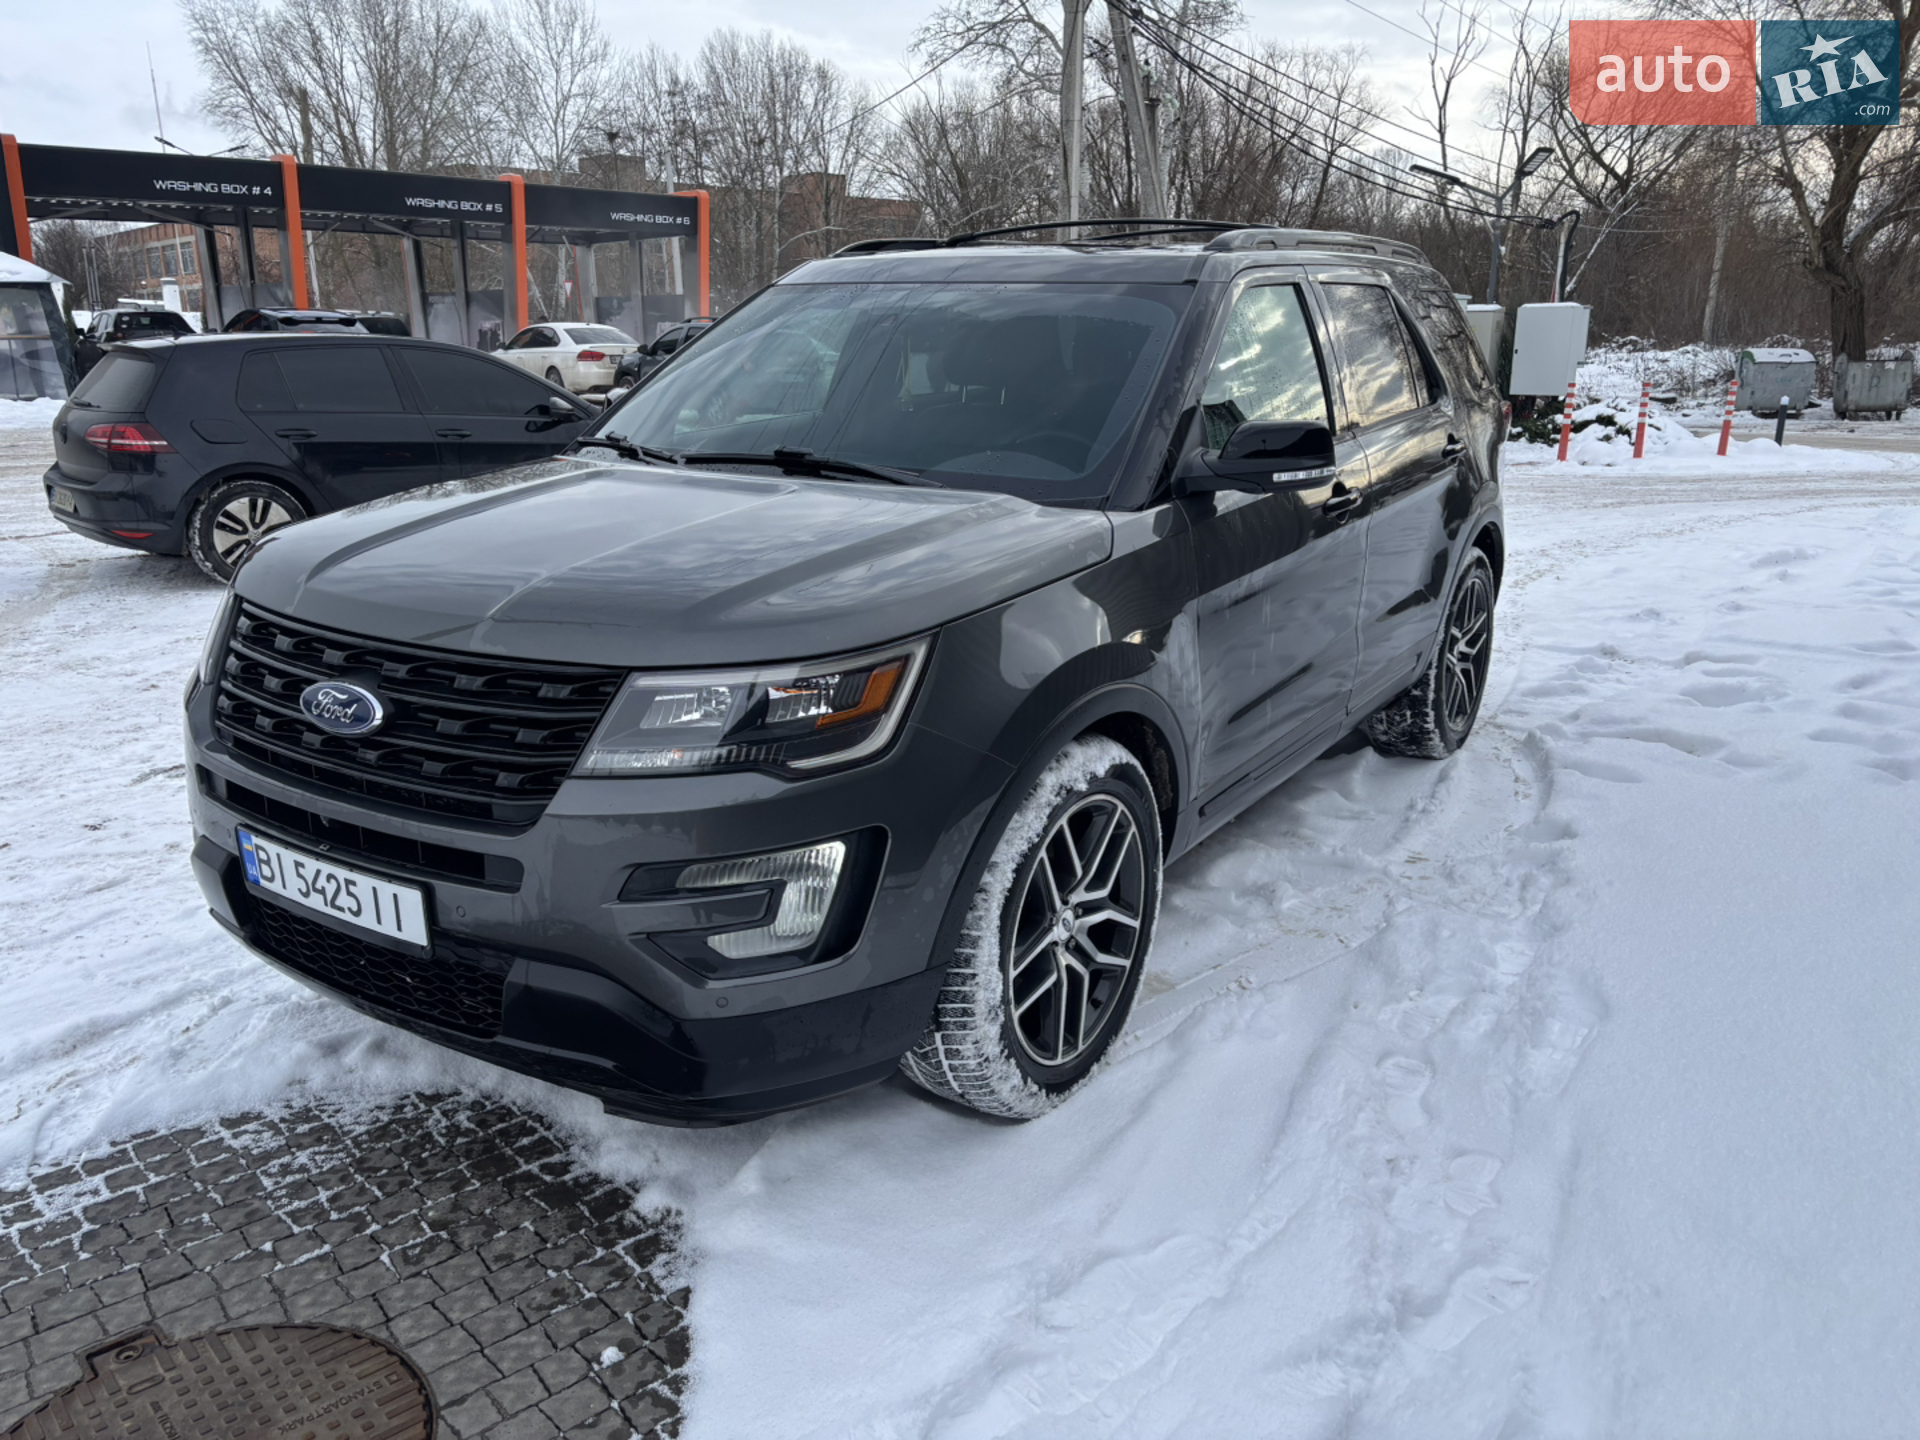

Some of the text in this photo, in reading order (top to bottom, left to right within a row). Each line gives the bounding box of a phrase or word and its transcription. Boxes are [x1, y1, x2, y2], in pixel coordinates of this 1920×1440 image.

[153, 179, 273, 196] WASHING BOX # 4
[404, 196, 503, 213] WASHING BOX # 5
[610, 212, 654, 223] WASHING
[655, 214, 675, 224] BOX
[683, 216, 691, 225] 6
[311, 688, 358, 724] Ford
[254, 843, 403, 933] BI 5425 II
[277, 1380, 384, 1436] STANDARTPARK
